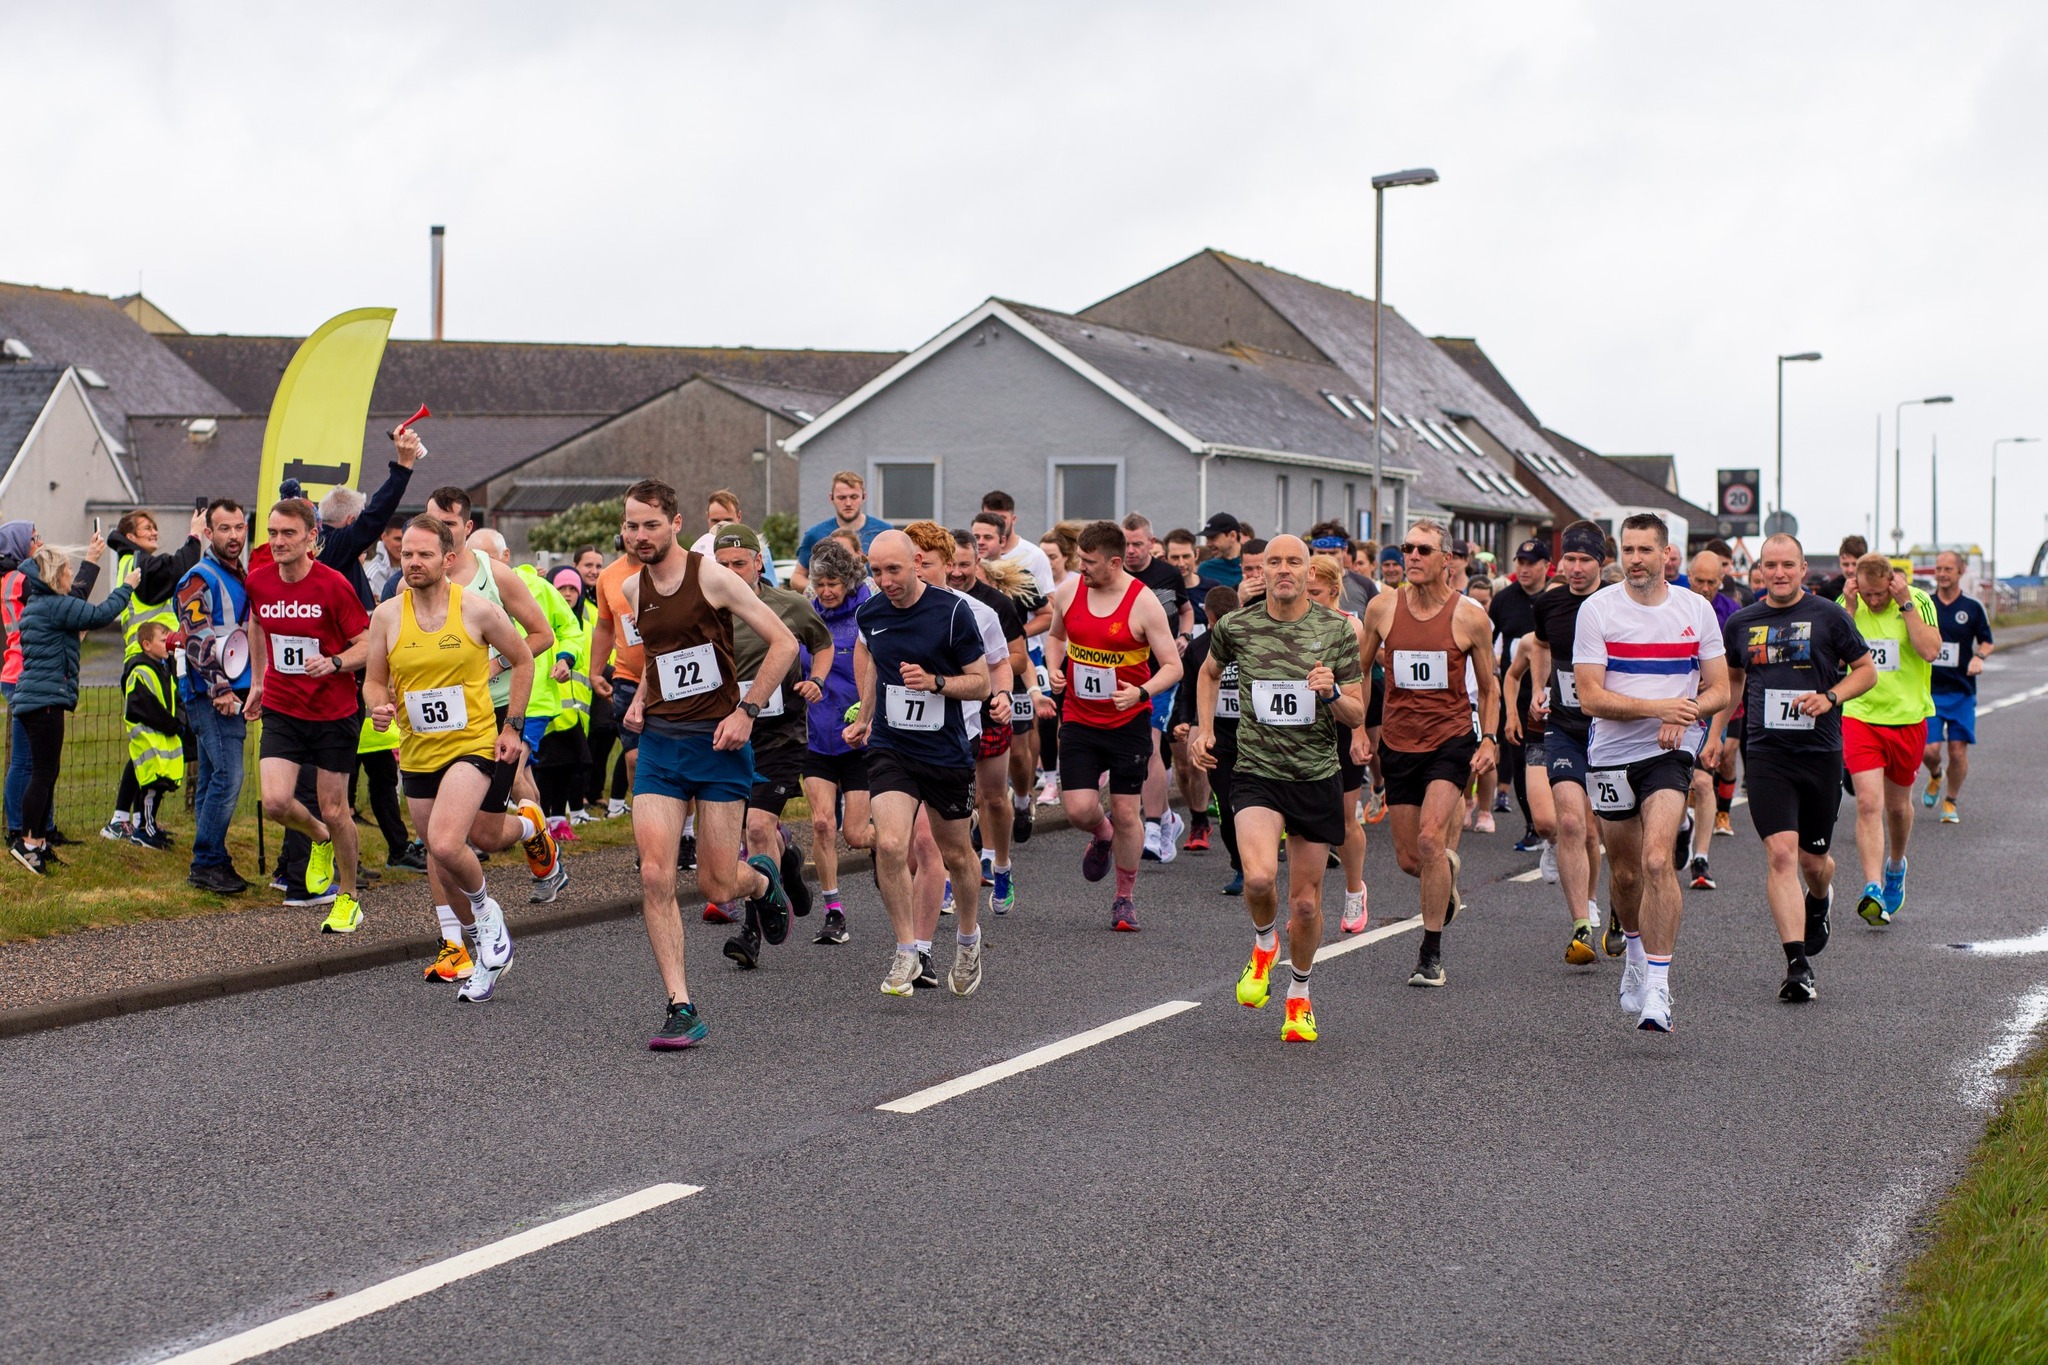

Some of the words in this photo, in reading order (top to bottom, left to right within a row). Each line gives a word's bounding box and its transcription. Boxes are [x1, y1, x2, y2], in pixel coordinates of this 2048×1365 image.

[1729, 492, 1748, 506] 20
[260, 600, 322, 618] adidas
[284, 647, 303, 666] 81
[1870, 648, 1886, 665] 23
[674, 661, 703, 688] 22
[1410, 662, 1430, 681] 10
[1084, 676, 1101, 693] 41
[421, 700, 449, 723] 53
[904, 700, 925, 721] 77
[1014, 701, 1031, 715] 65
[1222, 698, 1239, 712] 76
[1270, 693, 1297, 715] 46
[1780, 702, 1800, 721] 74
[1597, 782, 1619, 803] 25
